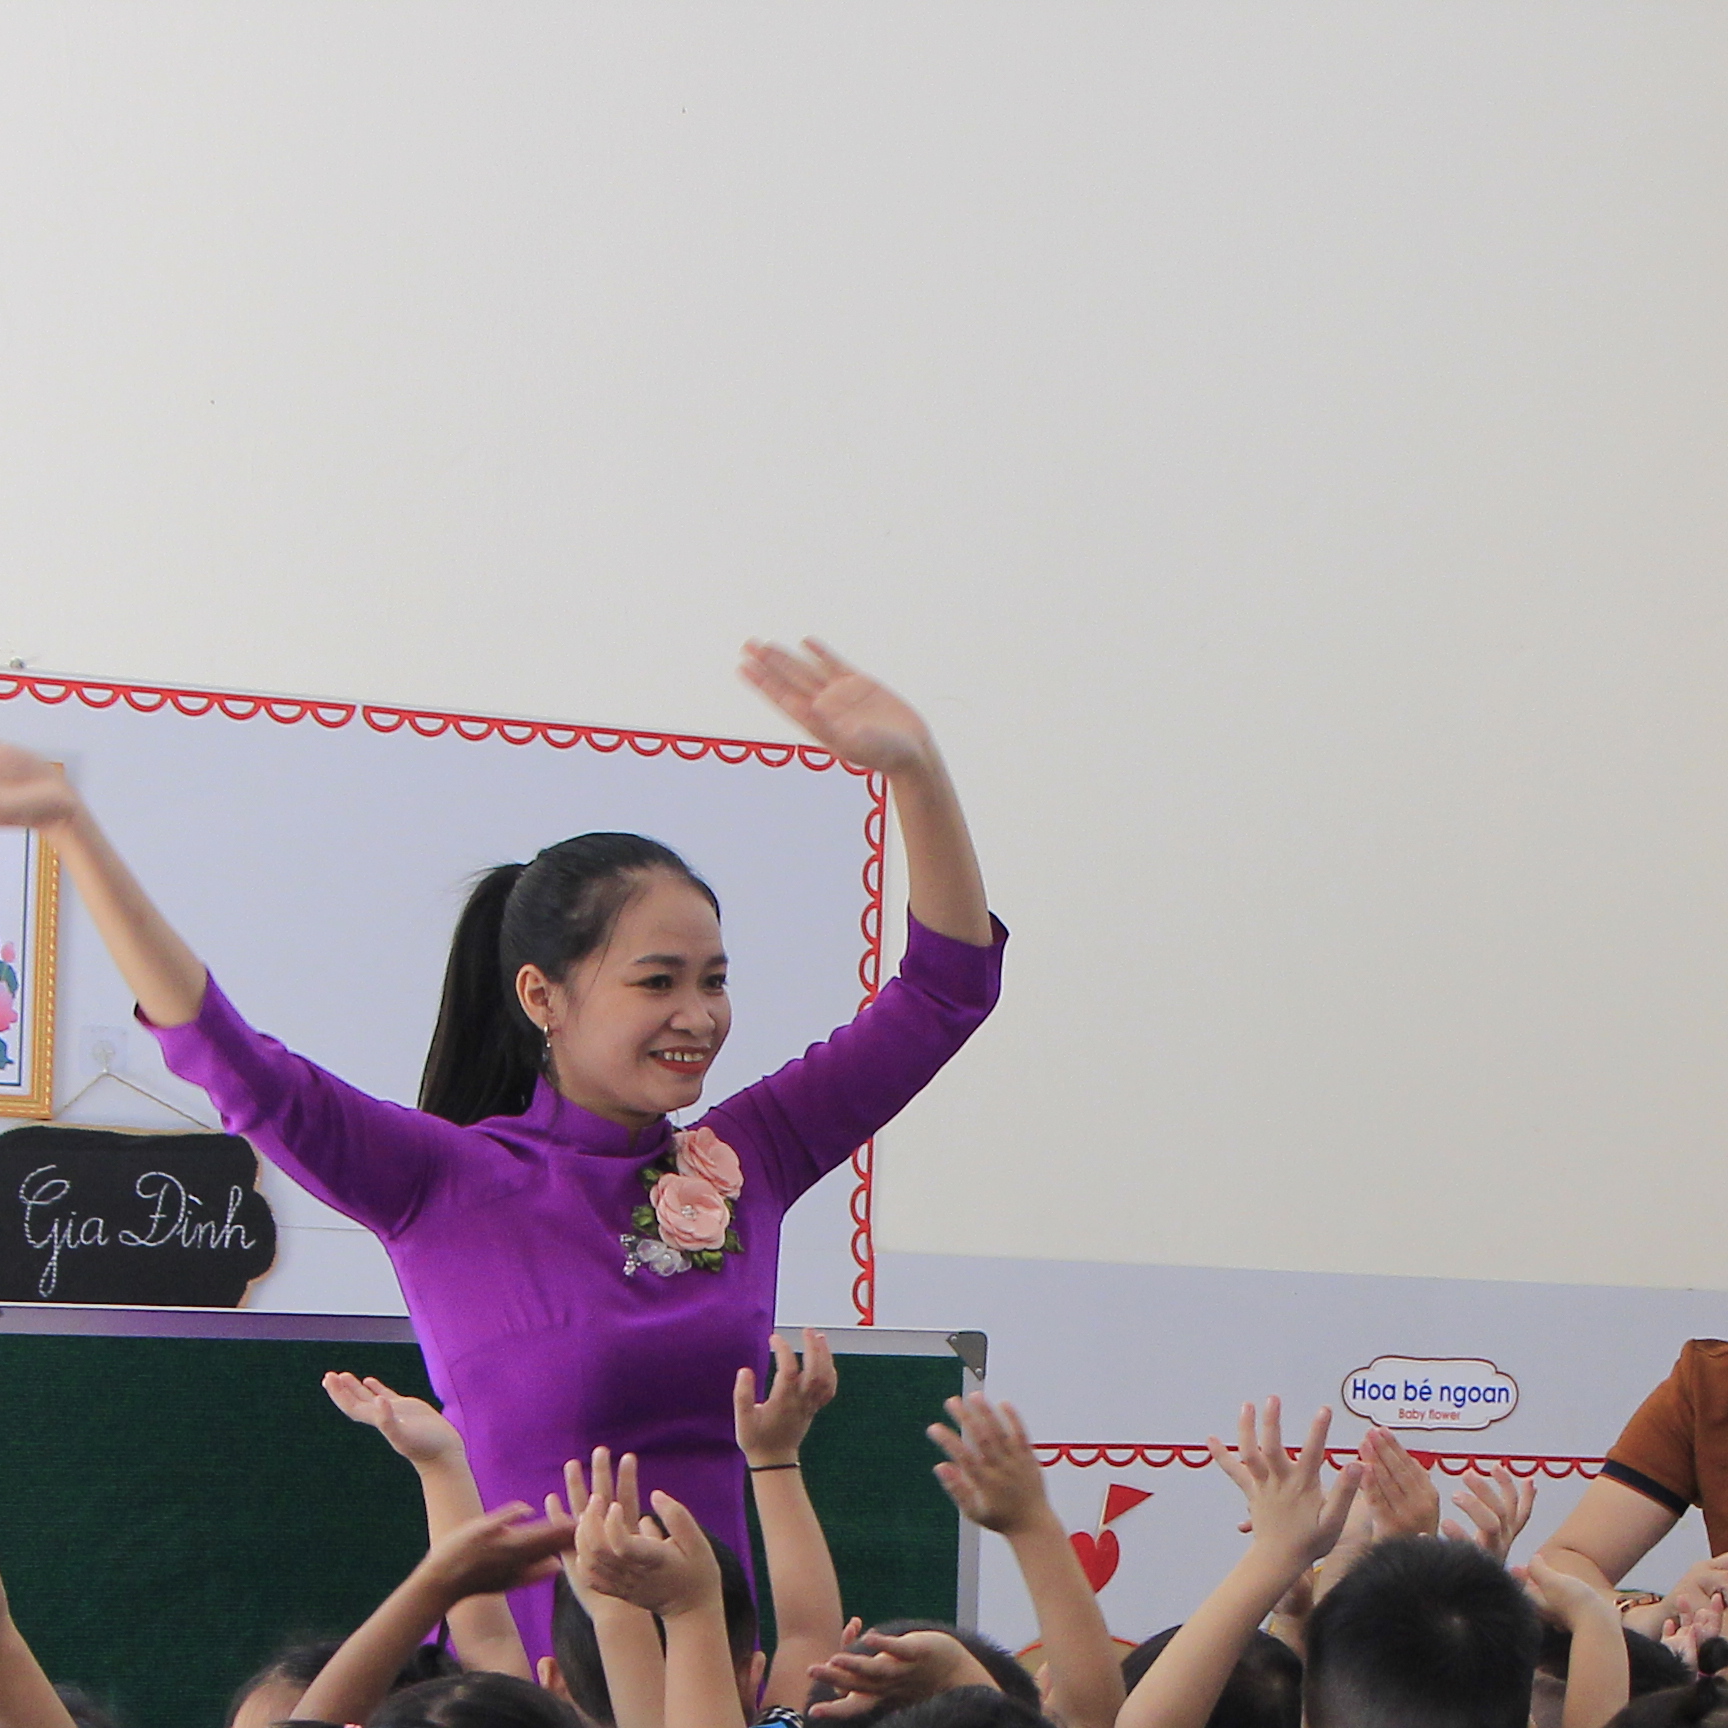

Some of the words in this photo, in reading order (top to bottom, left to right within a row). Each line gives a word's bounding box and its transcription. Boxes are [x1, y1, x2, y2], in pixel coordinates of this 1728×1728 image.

[18, 1164, 110, 1298] Gia
[118, 1171, 257, 1249] Đình
[1352, 1378, 1396, 1401] Hoa
[1404, 1379, 1432, 1402] bé
[1440, 1386, 1510, 1408] ngoan
[1398, 1408, 1426, 1421] Baby
[1428, 1409, 1460, 1421] flower
